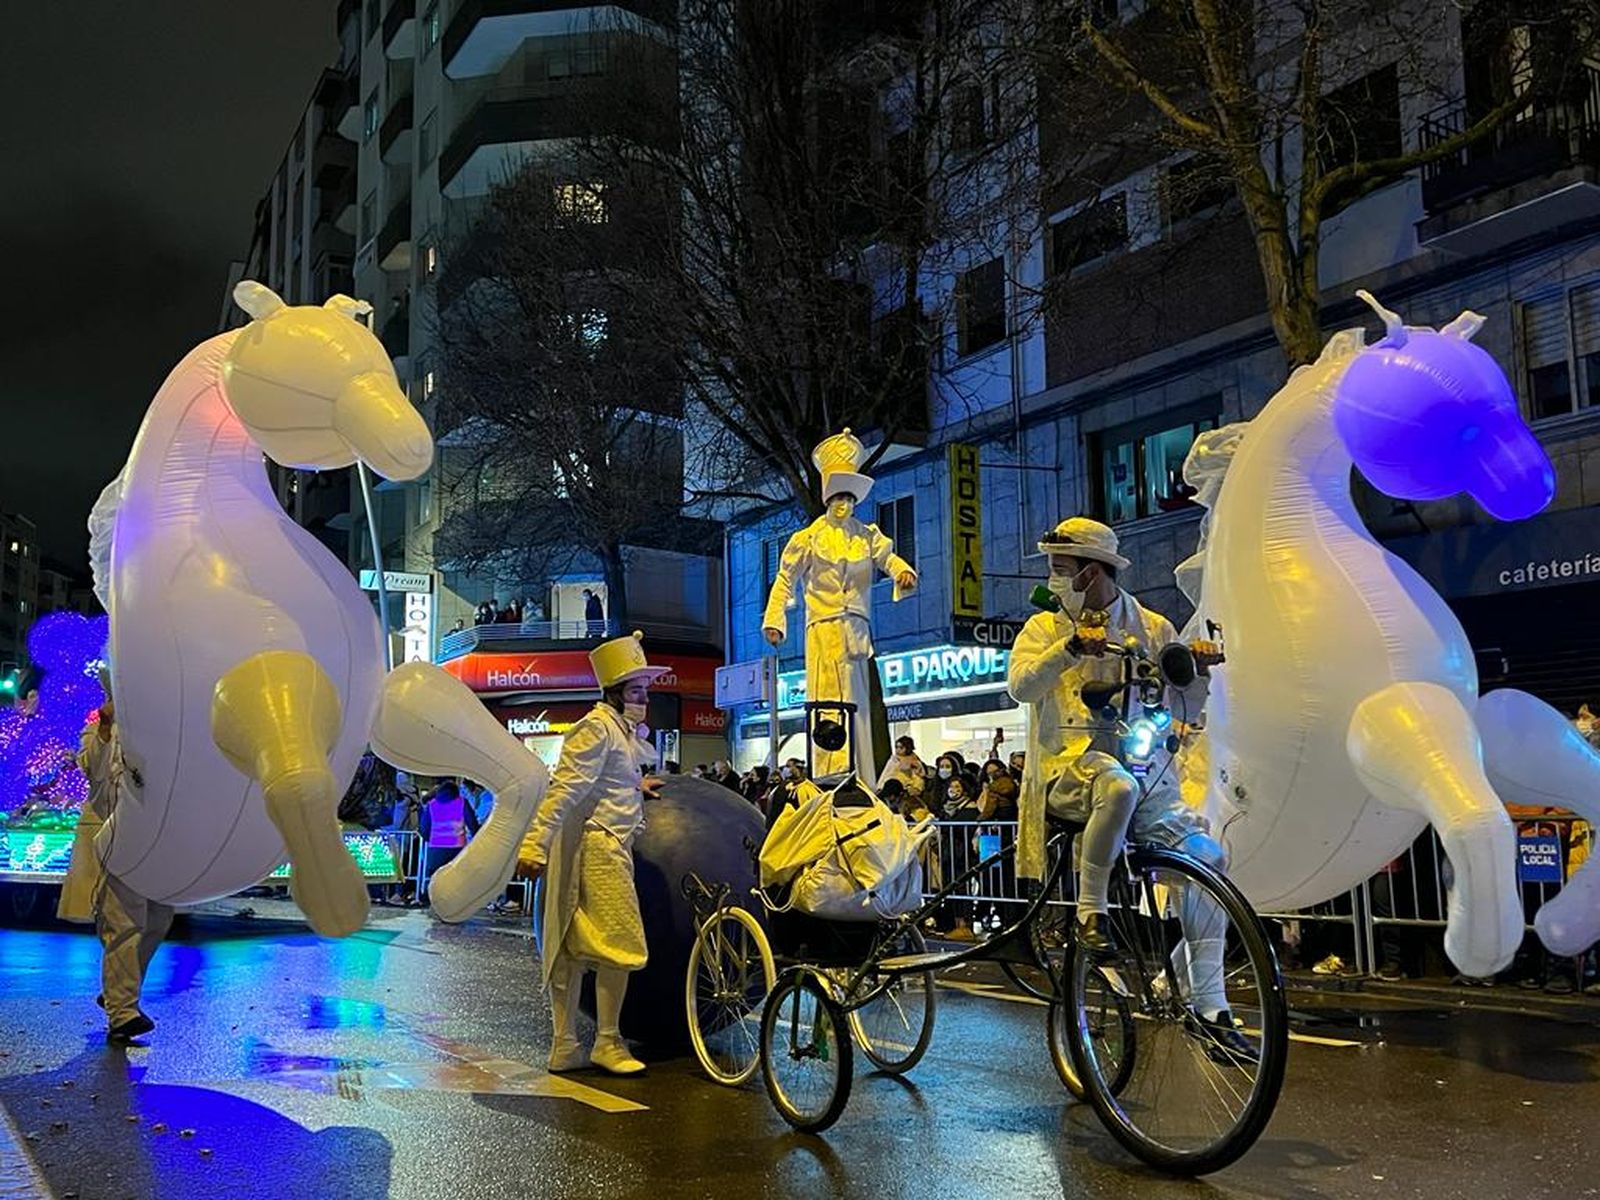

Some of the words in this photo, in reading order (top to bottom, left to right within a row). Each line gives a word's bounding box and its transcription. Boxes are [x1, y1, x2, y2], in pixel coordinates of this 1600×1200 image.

[957, 450, 979, 610] HOSTAL
[1499, 553, 1600, 586] cafetería
[884, 658, 910, 688] EL
[911, 646, 1006, 682] PARQUE
[1523, 855, 1556, 866] LOCAL
